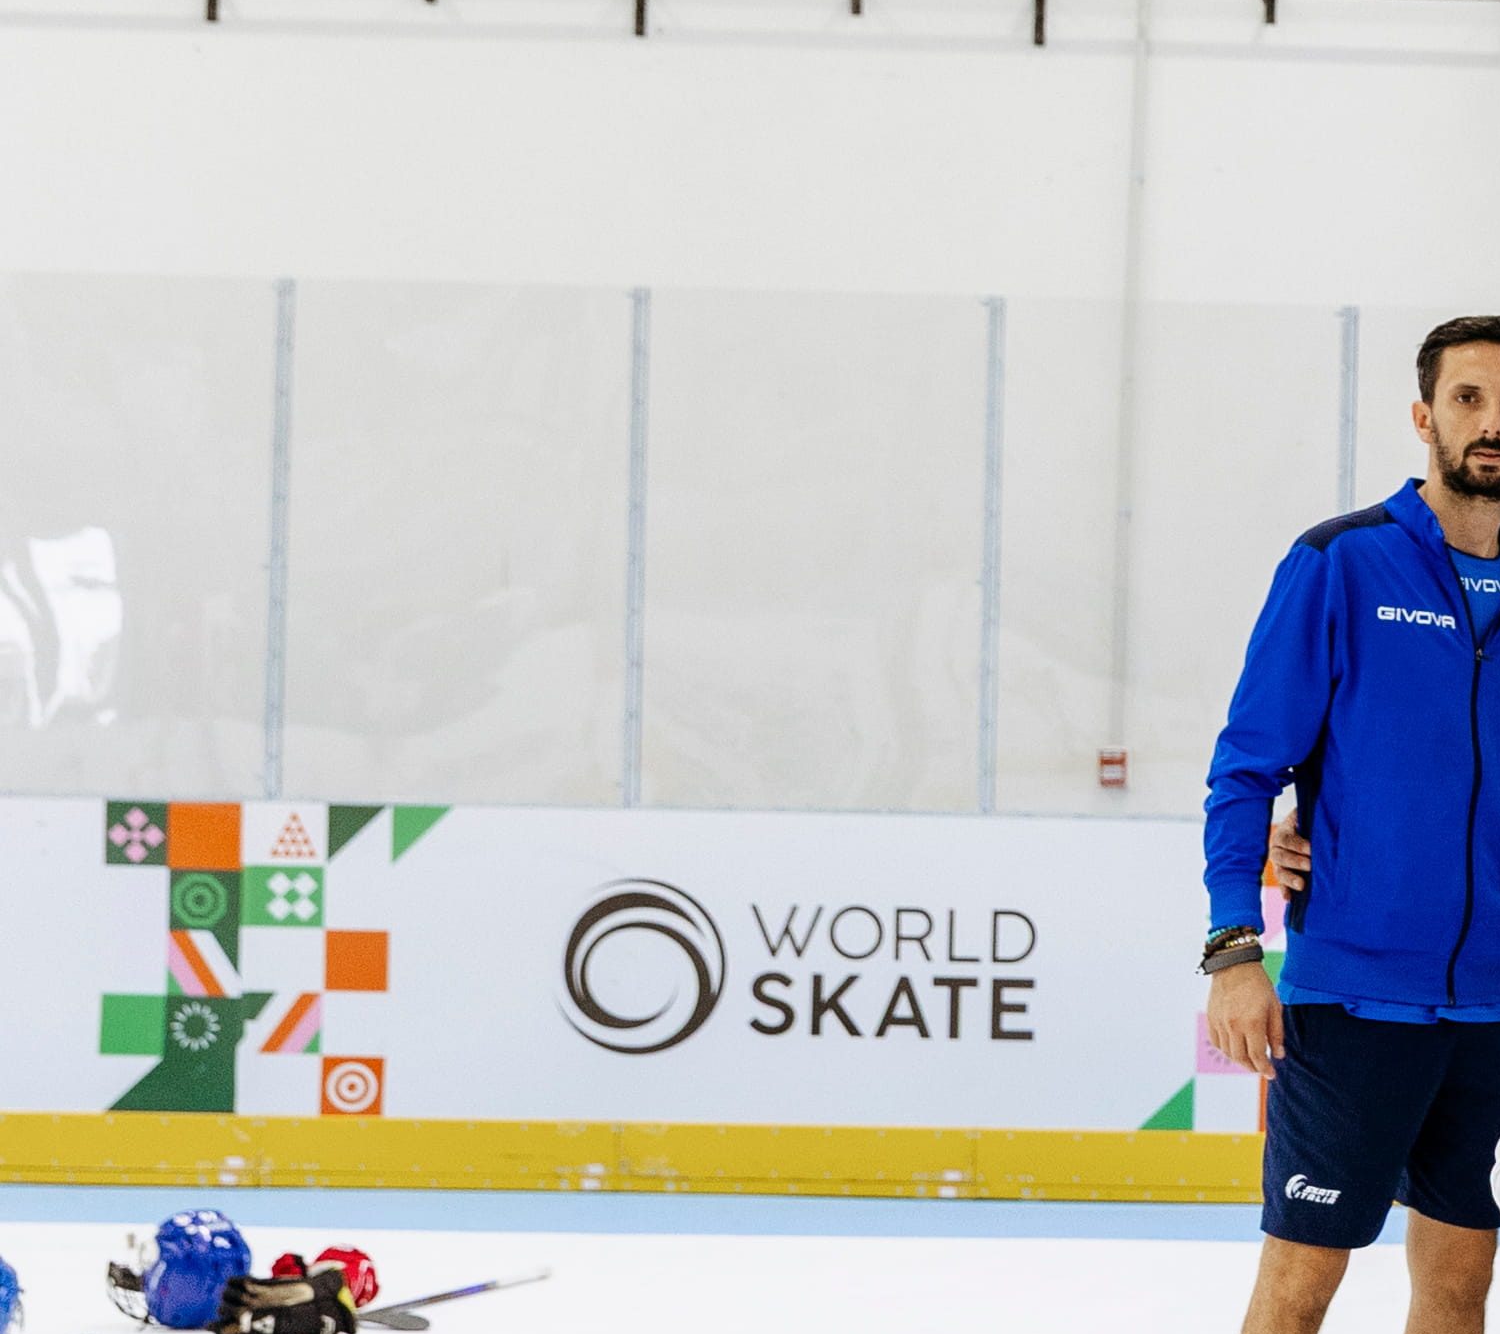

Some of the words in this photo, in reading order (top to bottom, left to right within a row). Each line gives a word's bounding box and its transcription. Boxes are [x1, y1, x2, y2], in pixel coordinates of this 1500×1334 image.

[1377, 606, 1457, 630] GIVOVA
[752, 903, 1036, 964] WORLD
[750, 972, 1035, 1041] SKATE
[1294, 1191, 1338, 1205] ITALIA
